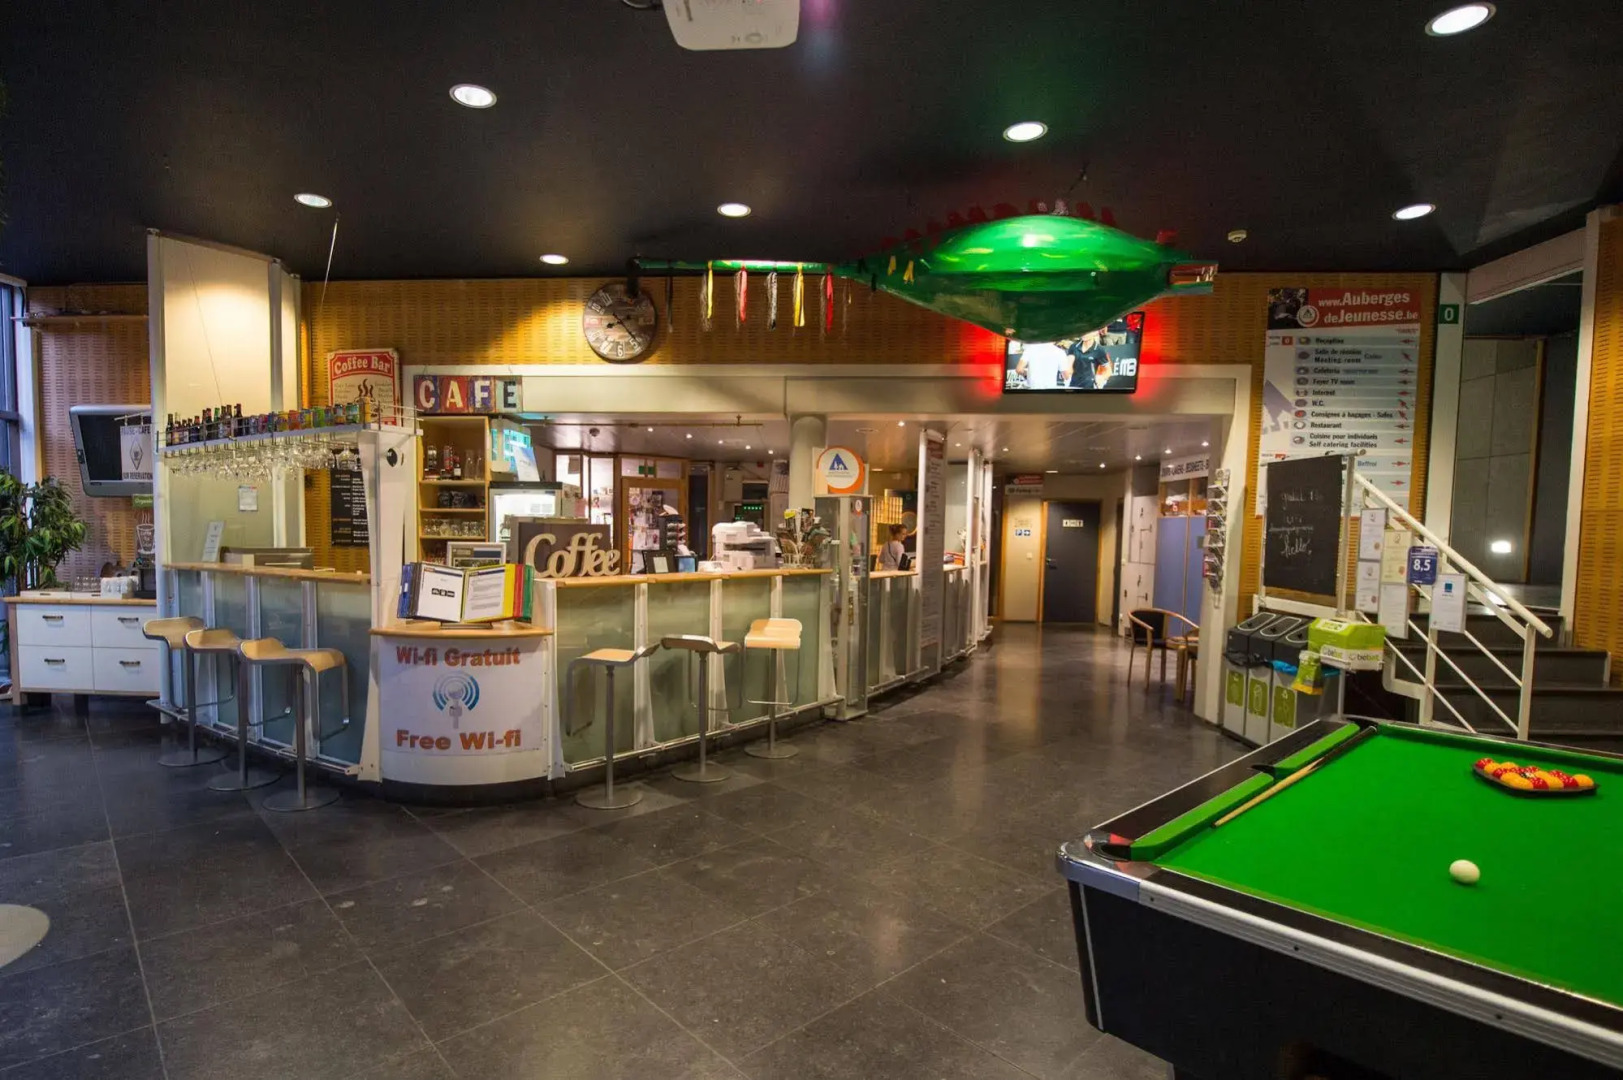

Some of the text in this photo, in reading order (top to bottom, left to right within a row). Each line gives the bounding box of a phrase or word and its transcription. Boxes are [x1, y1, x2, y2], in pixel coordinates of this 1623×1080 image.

[1318, 292, 1411, 307] www.Auberges
[1324, 309, 1419, 324] deJeunesse.be
[334, 356, 390, 375] Coffee Bar
[419, 379, 517, 409] CAFE
[1311, 411, 1340, 420] Consignes
[1309, 432, 1331, 440] Cuisine
[1332, 434, 1346, 442] pour
[523, 532, 621, 578] Coffee
[1413, 558, 1431, 572] 8,5
[396, 646, 521, 667] Wi-fi Gratuit
[396, 729, 521, 750] Free Wi-fi
